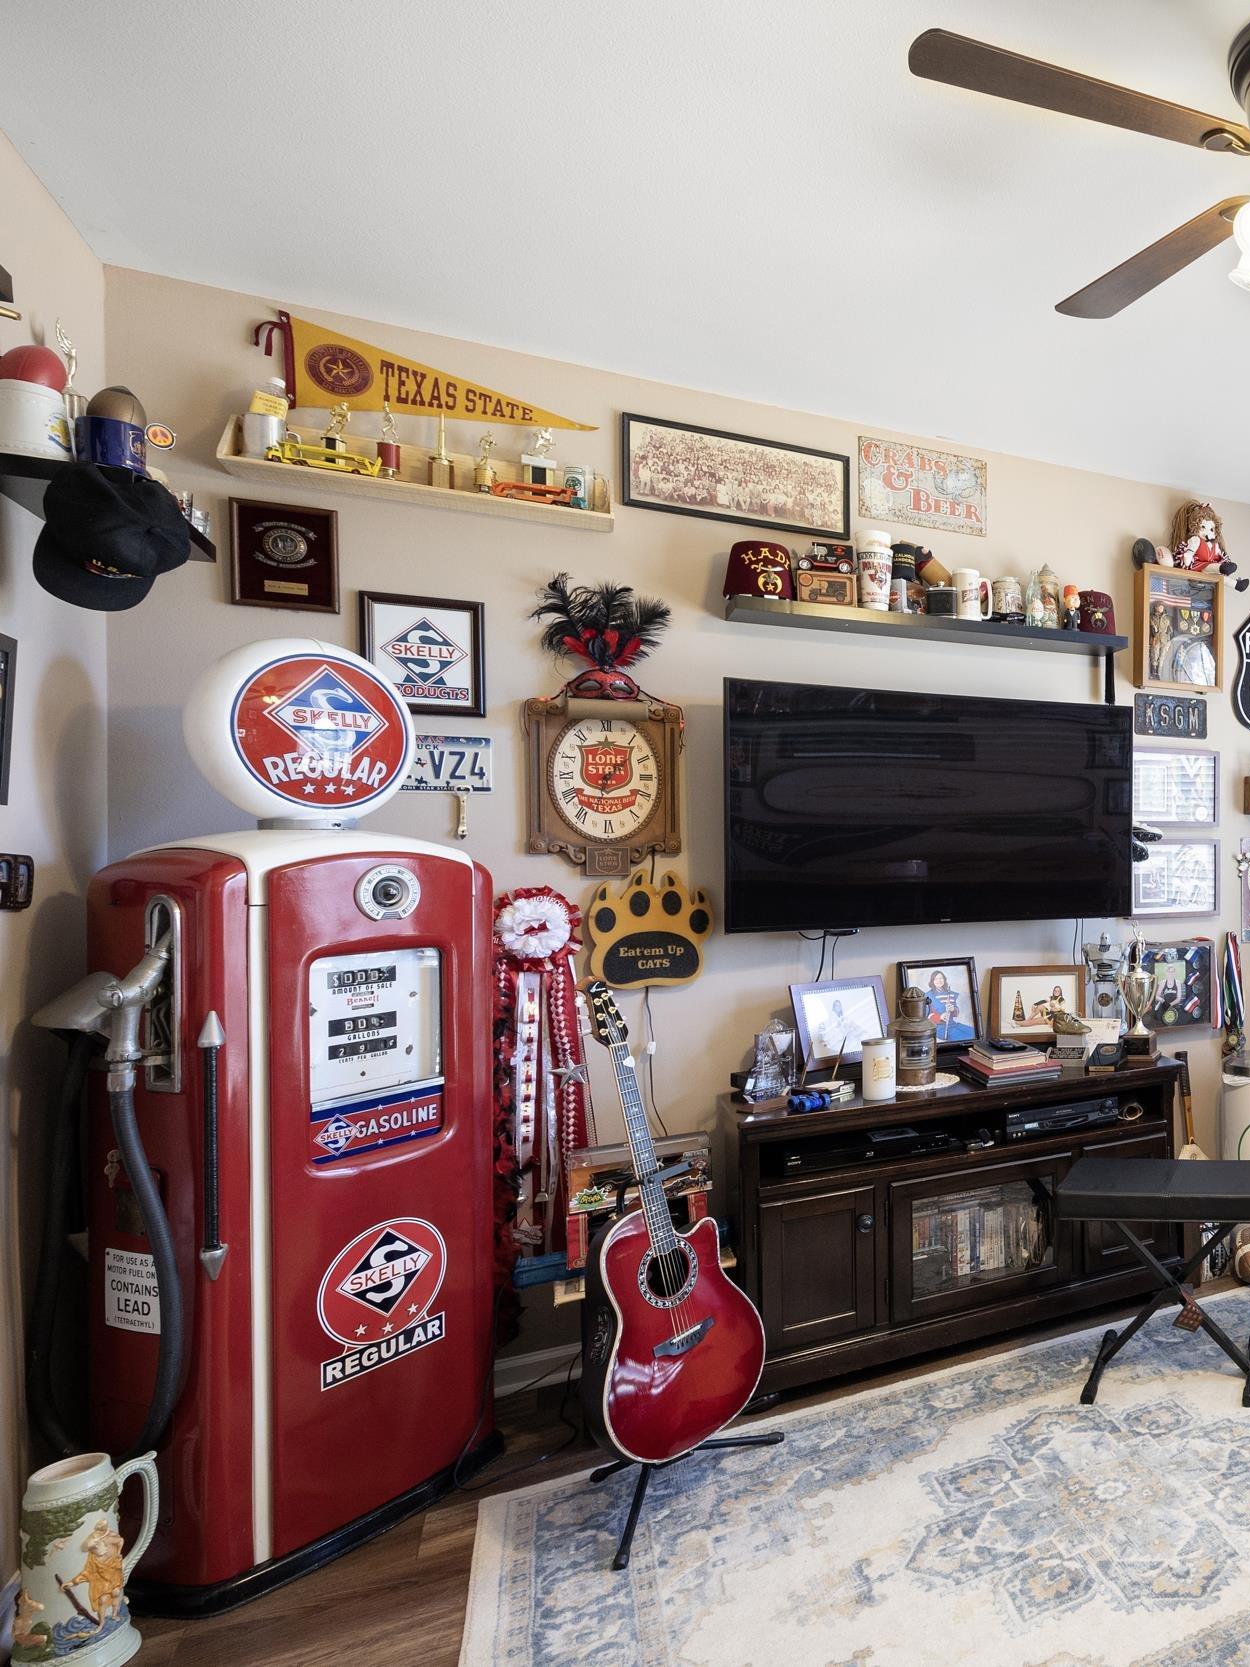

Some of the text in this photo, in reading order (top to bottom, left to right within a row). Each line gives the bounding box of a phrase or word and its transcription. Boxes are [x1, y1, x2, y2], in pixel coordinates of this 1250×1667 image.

[380, 359, 457, 411] TEXAS
[465, 388, 533, 421] STATE
[862, 441, 948, 480] CRABS
[882, 464, 913, 493] &
[908, 487, 983, 524] BEER
[741, 548, 790, 570] HADI
[391, 644, 455, 658] SKELLY
[394, 684, 468, 700] RODUCTS
[293, 709, 371, 729] SKELLY
[588, 754, 625, 763] LONE
[262, 751, 387, 788] REGULAR
[591, 796, 621, 804] NATIONAL
[592, 803, 623, 812] TEXAS
[667, 945, 684, 956] Up
[638, 959, 670, 969] CATS
[332, 986, 361, 995] AMOUNT
[347, 1030, 380, 1041] GALLONS
[355, 1104, 437, 1138] GASOLINE
[320, 1128, 353, 1142] SKELLY
[113, 1254, 124, 1262] FOR
[126, 1256, 138, 1265] USE
[140, 1259, 148, 1267] AS
[107, 1264, 127, 1275] MOTOR
[129, 1268, 144, 1278] FUEL
[350, 1254, 421, 1291] SKELLY
[111, 1279, 159, 1297] CONTAINS
[117, 1297, 151, 1316] LEAD
[114, 1315, 155, 1329] (TETRAETHYL)
[326, 1319, 440, 1383] REGULAR
